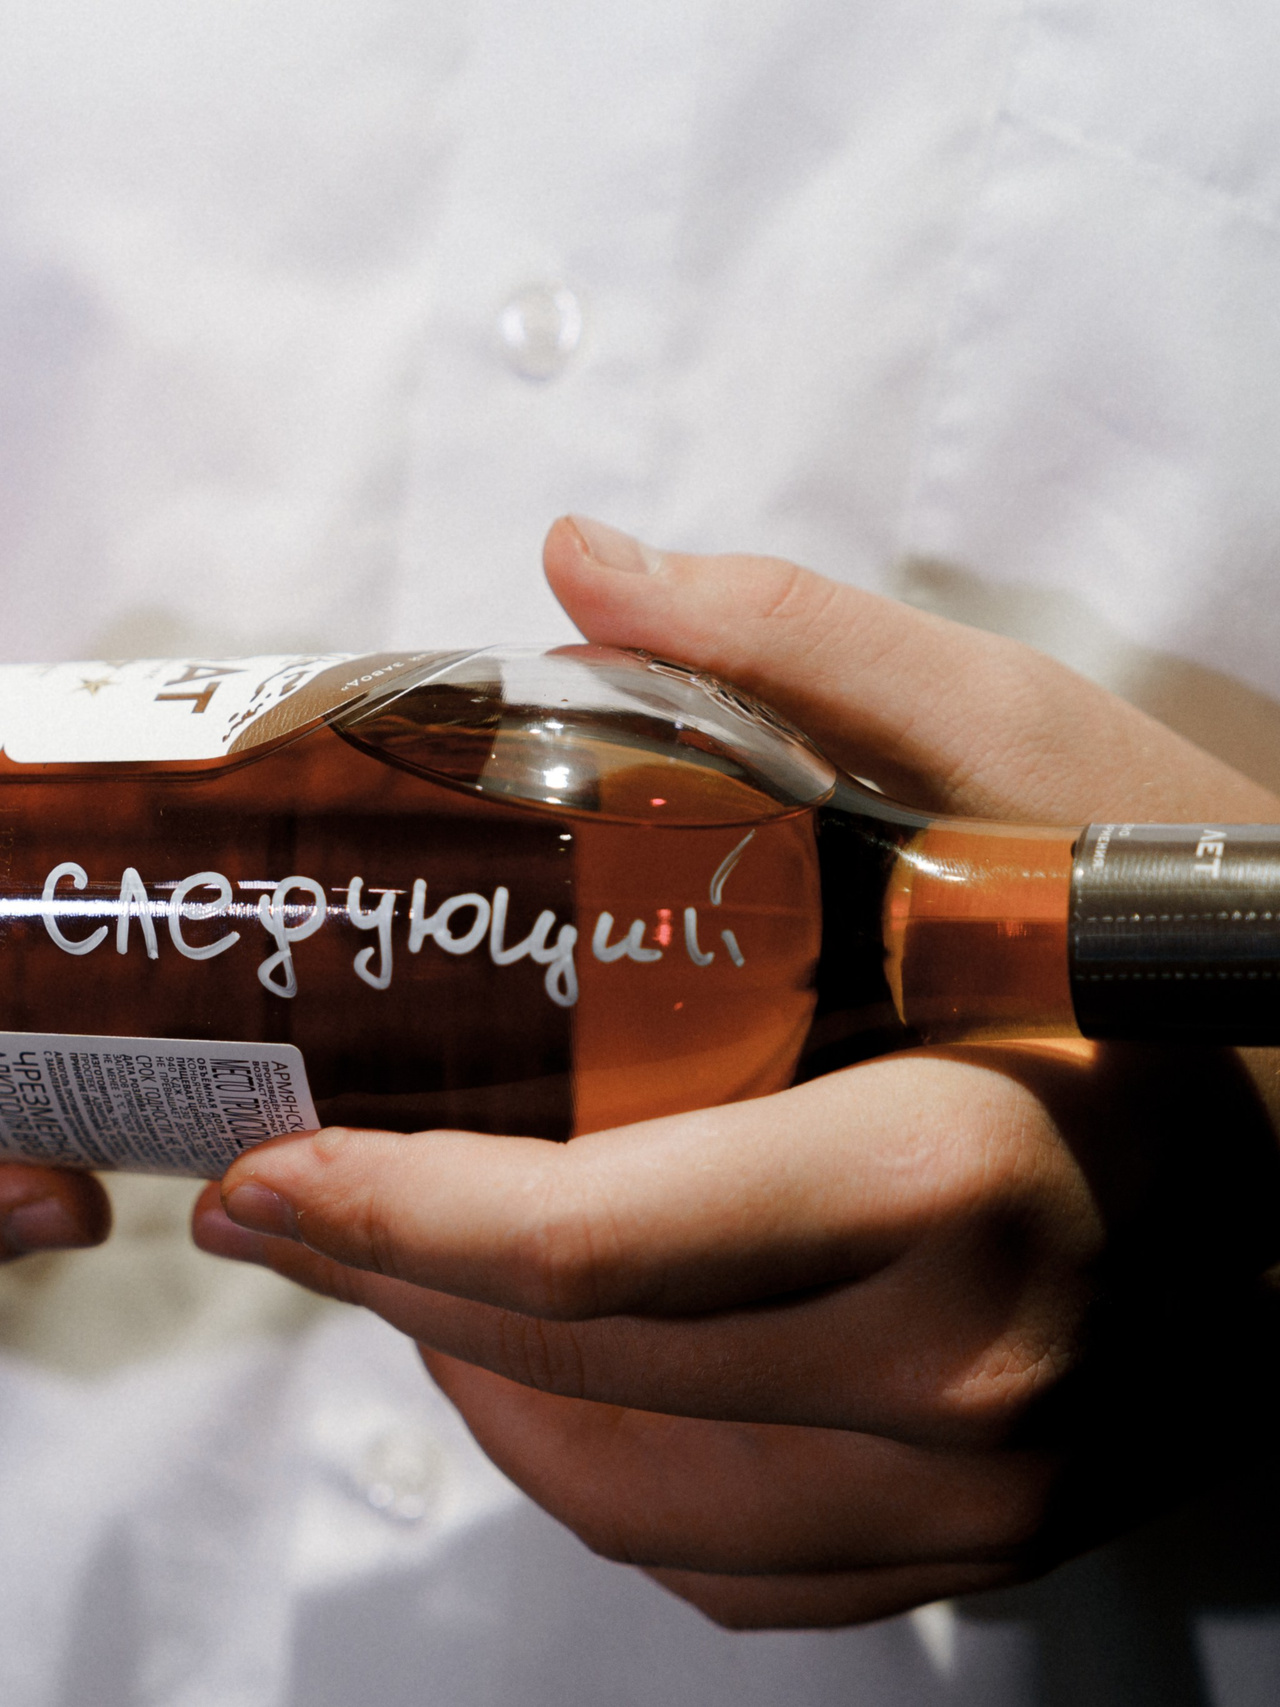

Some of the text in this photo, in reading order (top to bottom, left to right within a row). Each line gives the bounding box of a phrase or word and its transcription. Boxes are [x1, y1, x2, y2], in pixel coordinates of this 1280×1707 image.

[1193, 829, 1228, 878] ЛЕТ
[53, 1051, 71, 1087] АЛКОГОЛЬ
[69, 1052, 88, 1093] ПРИНЯТИЕ
[80, 1053, 98, 1092] ПРОСПЕКТ
[103, 1053, 113, 1064] НЕ
[122, 1054, 137, 1075] ДАТА
[135, 1055, 156, 1082] СРОК
[155, 1056, 165, 1067] НЕ
[165, 1056, 177, 1072] 940
[176, 1057, 195, 1100] ПИЩЕВАЯ
[209, 1059, 256, 1092] МЕСТО
[106, 1067, 120, 1091] МЕНЕЕ
[159, 1072, 181, 1119] ПРЕВЫШАЕТ
[186, 1057, 208, 1109] КОНЬЯЧНЫЕ
[197, 1058, 218, 1108] ОБЪЁМНАЯ
[252, 1061, 280, 1133] ВОЗРАСТ КОТОРЫХ
[261, 1061, 281, 1112] ПРОИЗВЕДЁН
[142, 1086, 175, 1134] ГОДНОСТИ
